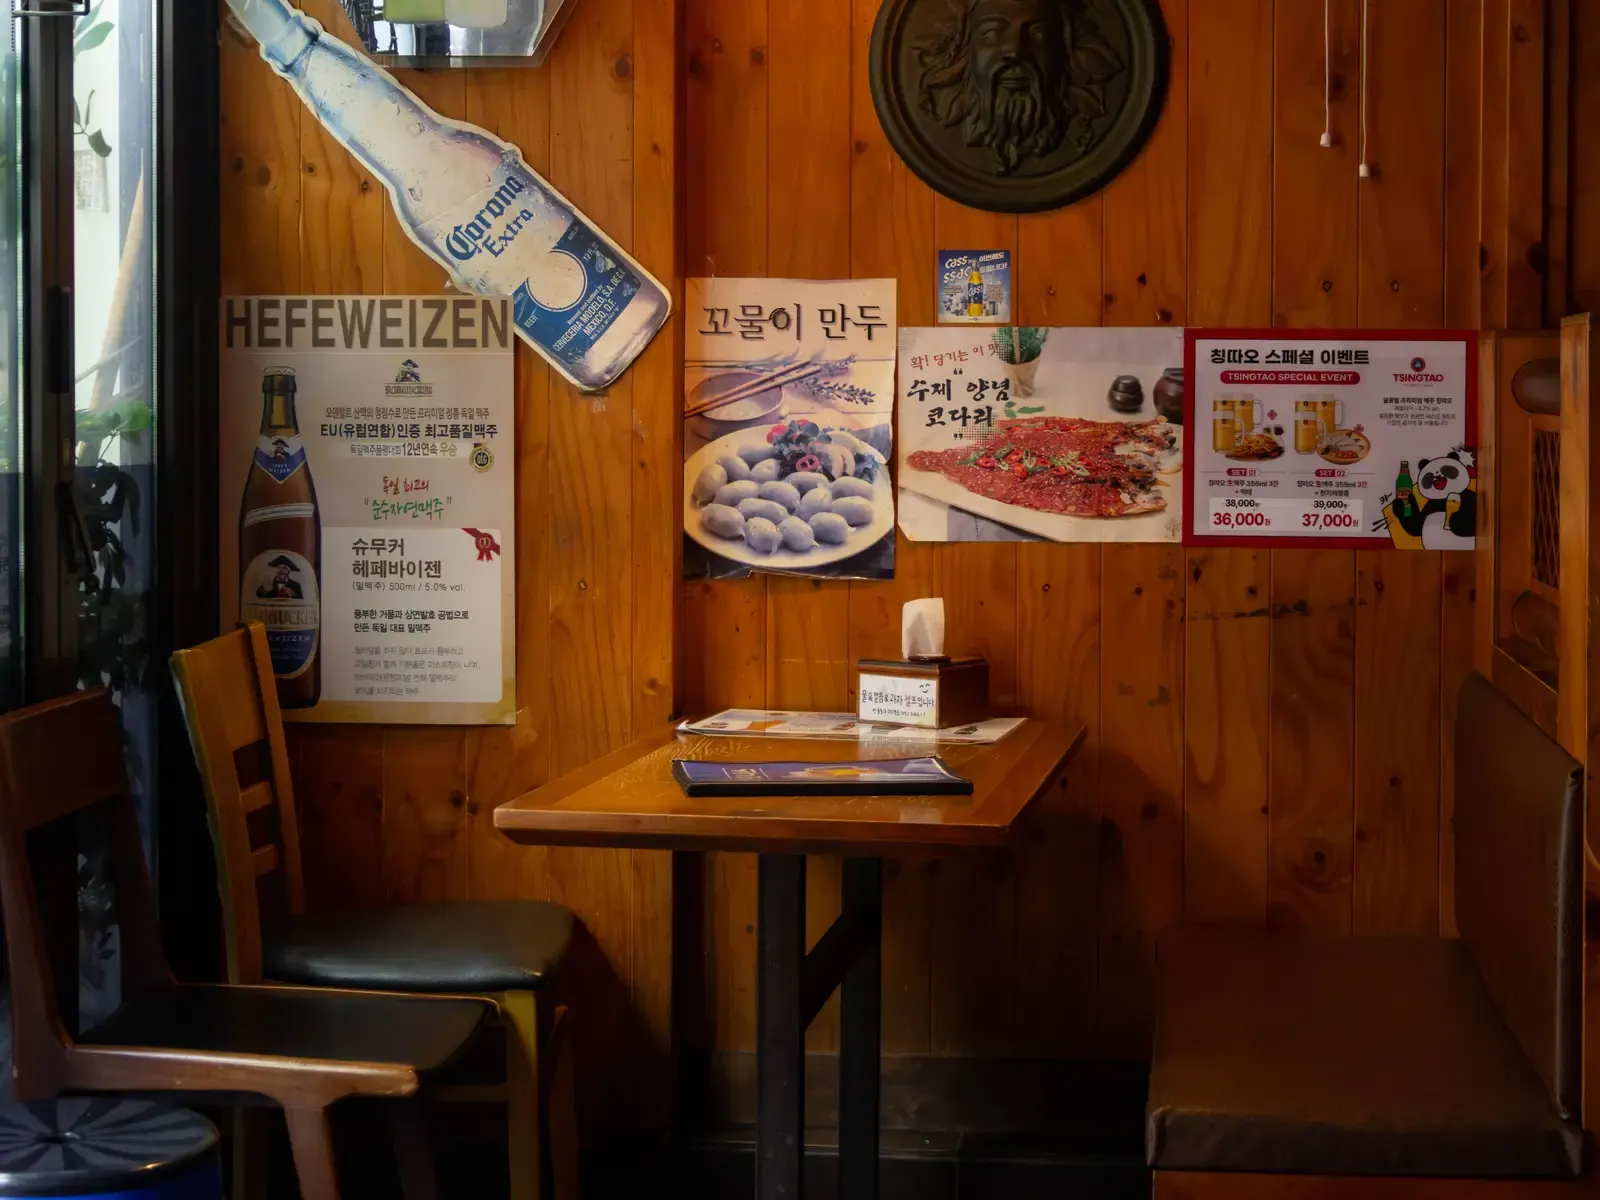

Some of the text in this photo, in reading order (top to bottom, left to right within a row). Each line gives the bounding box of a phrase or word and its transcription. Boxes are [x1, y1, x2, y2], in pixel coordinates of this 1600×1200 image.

[446, 176, 525, 261] Corona
[481, 207, 534, 258] Extra
[523, 313, 538, 328] BEER
[552, 319, 583, 352] CERVECERIA
[579, 294, 606, 323] MODELO,
[601, 283, 614, 296] S.A.
[610, 275, 620, 285] DE
[582, 308, 607, 335] MEXICO,
[604, 298, 616, 311] D.F.
[698, 303, 888, 340] 꼬물이 만두
[226, 299, 508, 348] HEFEWEIZEN
[934, 348, 969, 368] 당기는
[972, 346, 984, 357] 이
[1210, 348, 1370, 365] 칭따오 스페셜 이벤트
[1228, 372, 1353, 382] TSINGTAO SPECIAL EVENT
[1392, 374, 1444, 382] TSINGTAO
[906, 378, 1010, 402] 수제 양념
[418, 408, 445, 420] 프리미엄
[925, 405, 993, 428] 코다리
[320, 424, 420, 438] EU(유럽연합)인증
[382, 476, 430, 494] 독일 최고의
[352, 538, 404, 556] 슈무커
[352, 560, 442, 578] 헤페바이젠
[352, 581, 385, 592] (밀맥주)
[388, 582, 416, 591] 500ml
[425, 582, 447, 591] 5.0%
[450, 583, 465, 591] vol.
[354, 609, 378, 620] 풍부한
[380, 610, 402, 620] 거품과
[438, 610, 470, 620] 공법으로
[354, 623, 432, 633] 만든 독일 대표 밀맥주
